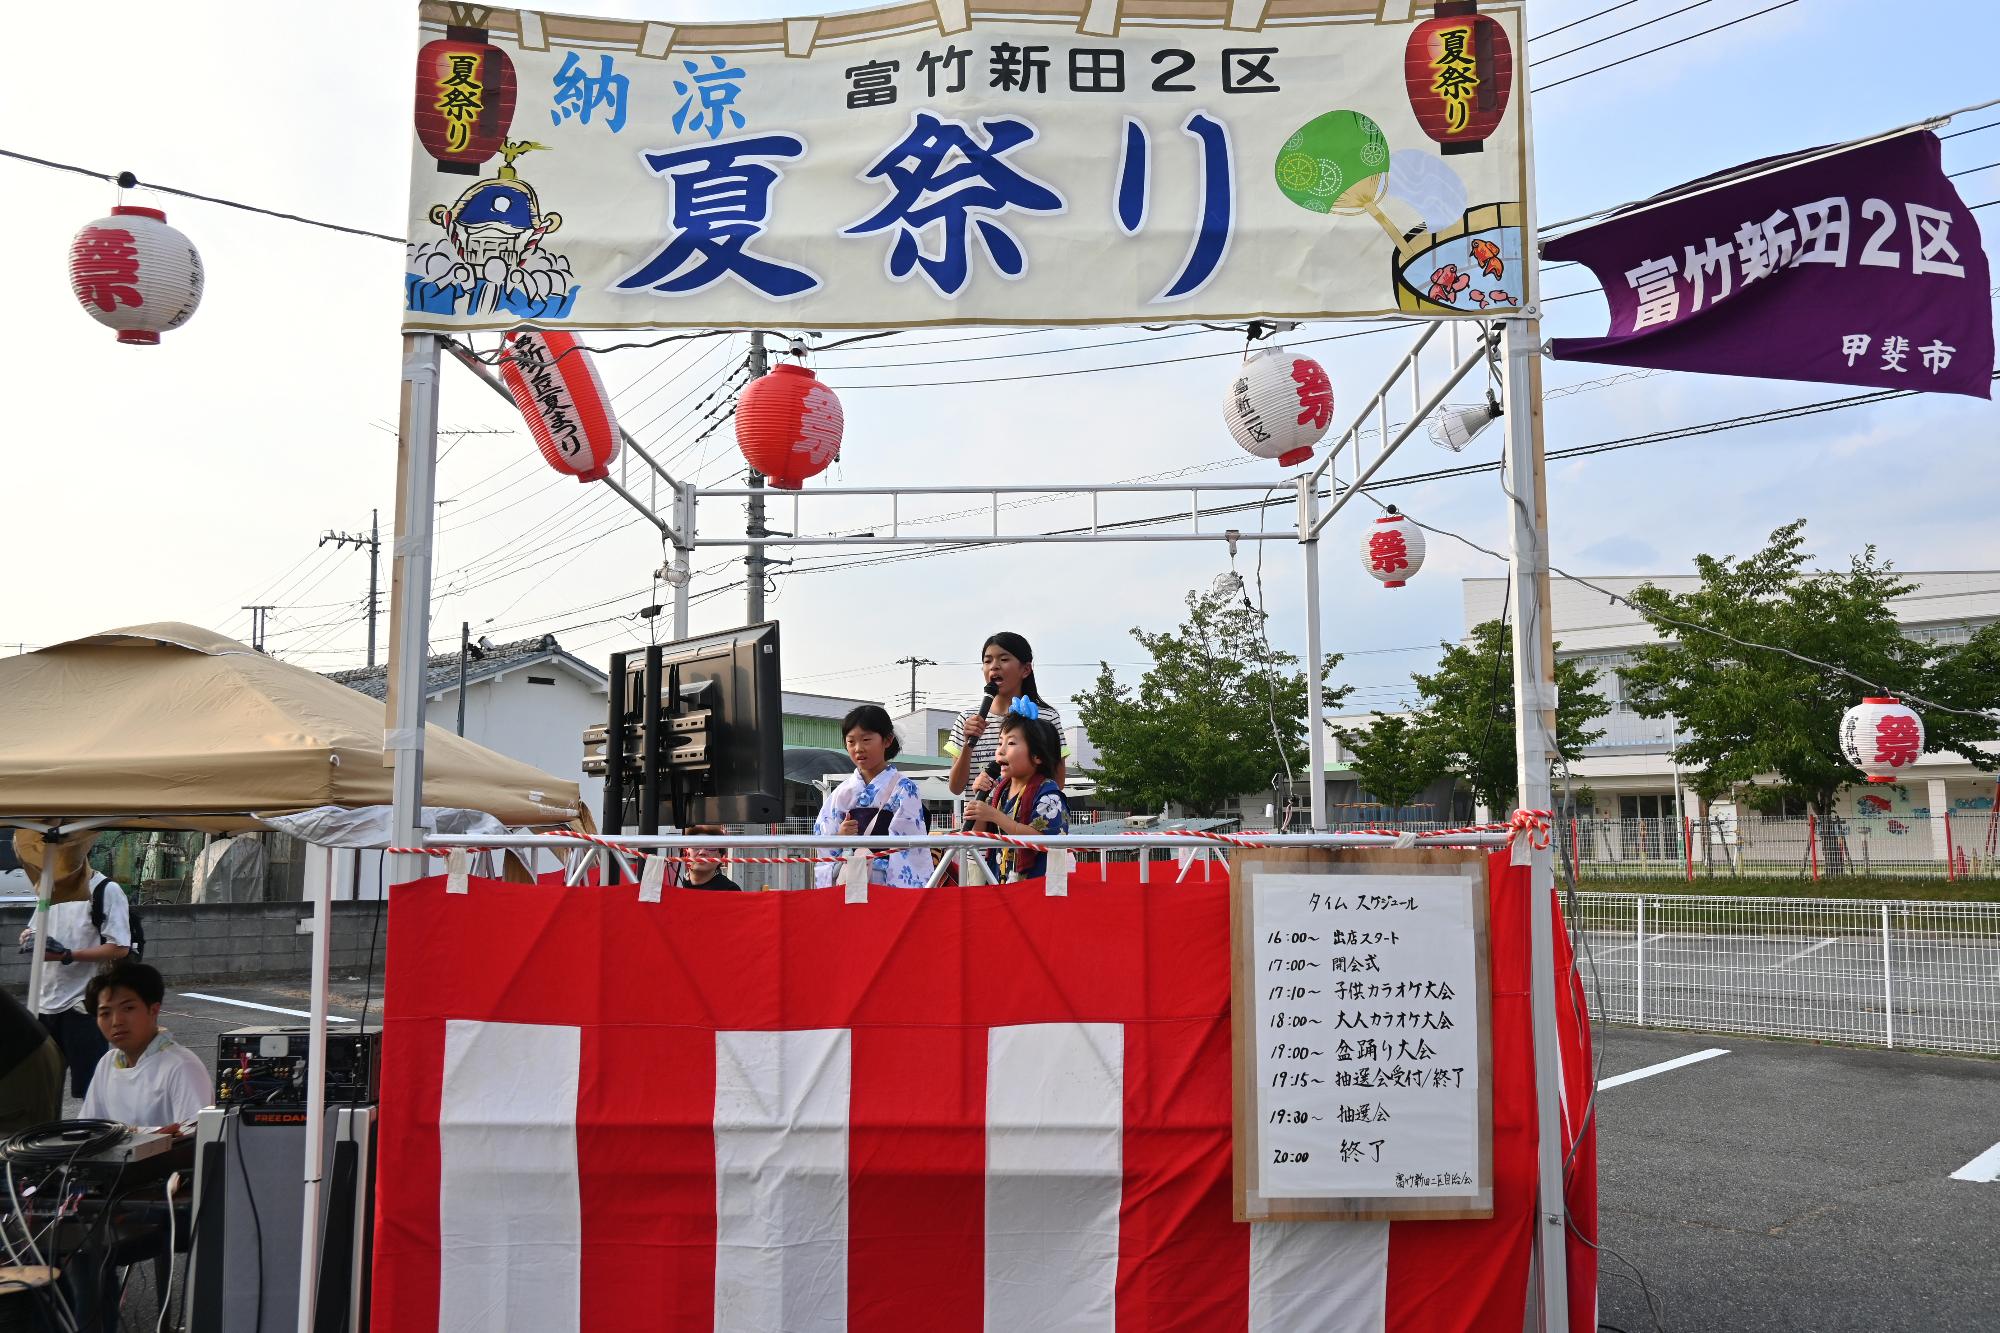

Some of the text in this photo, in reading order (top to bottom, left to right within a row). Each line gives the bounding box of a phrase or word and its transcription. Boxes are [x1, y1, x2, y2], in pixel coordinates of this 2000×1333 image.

[844, 42, 1281, 110] 富竹新田2区
[1434, 29, 1478, 130] 夏祭り
[438, 55, 483, 150] 夏祭り
[612, 110, 1236, 303] 夏祭り
[70, 226, 144, 313] 祭
[1624, 196, 1965, 333] 富竹新田2区
[1841, 333, 1957, 375] 甲斐市
[1290, 358, 1335, 430] 祭
[791, 386, 844, 465] 祭
[1368, 529, 1409, 574] 祭
[1873, 714, 1920, 768] 祭
[1308, 892, 1419, 912] タイム スケジュール
[1333, 929, 1400, 946] 出店スタート
[1332, 954, 1380, 973] 開会式
[1334, 980, 1455, 1001] 子供カラオケ大会
[1334, 1010, 1455, 1030] 大人カラオケ大会
[1335, 1038, 1437, 1062] 盆踊り大会
[1335, 1064, 1465, 1089] 抽選会受付/終了
[1336, 1101, 1391, 1123] 抽選会
[1273, 1139, 1386, 1164] 20:00 終了
